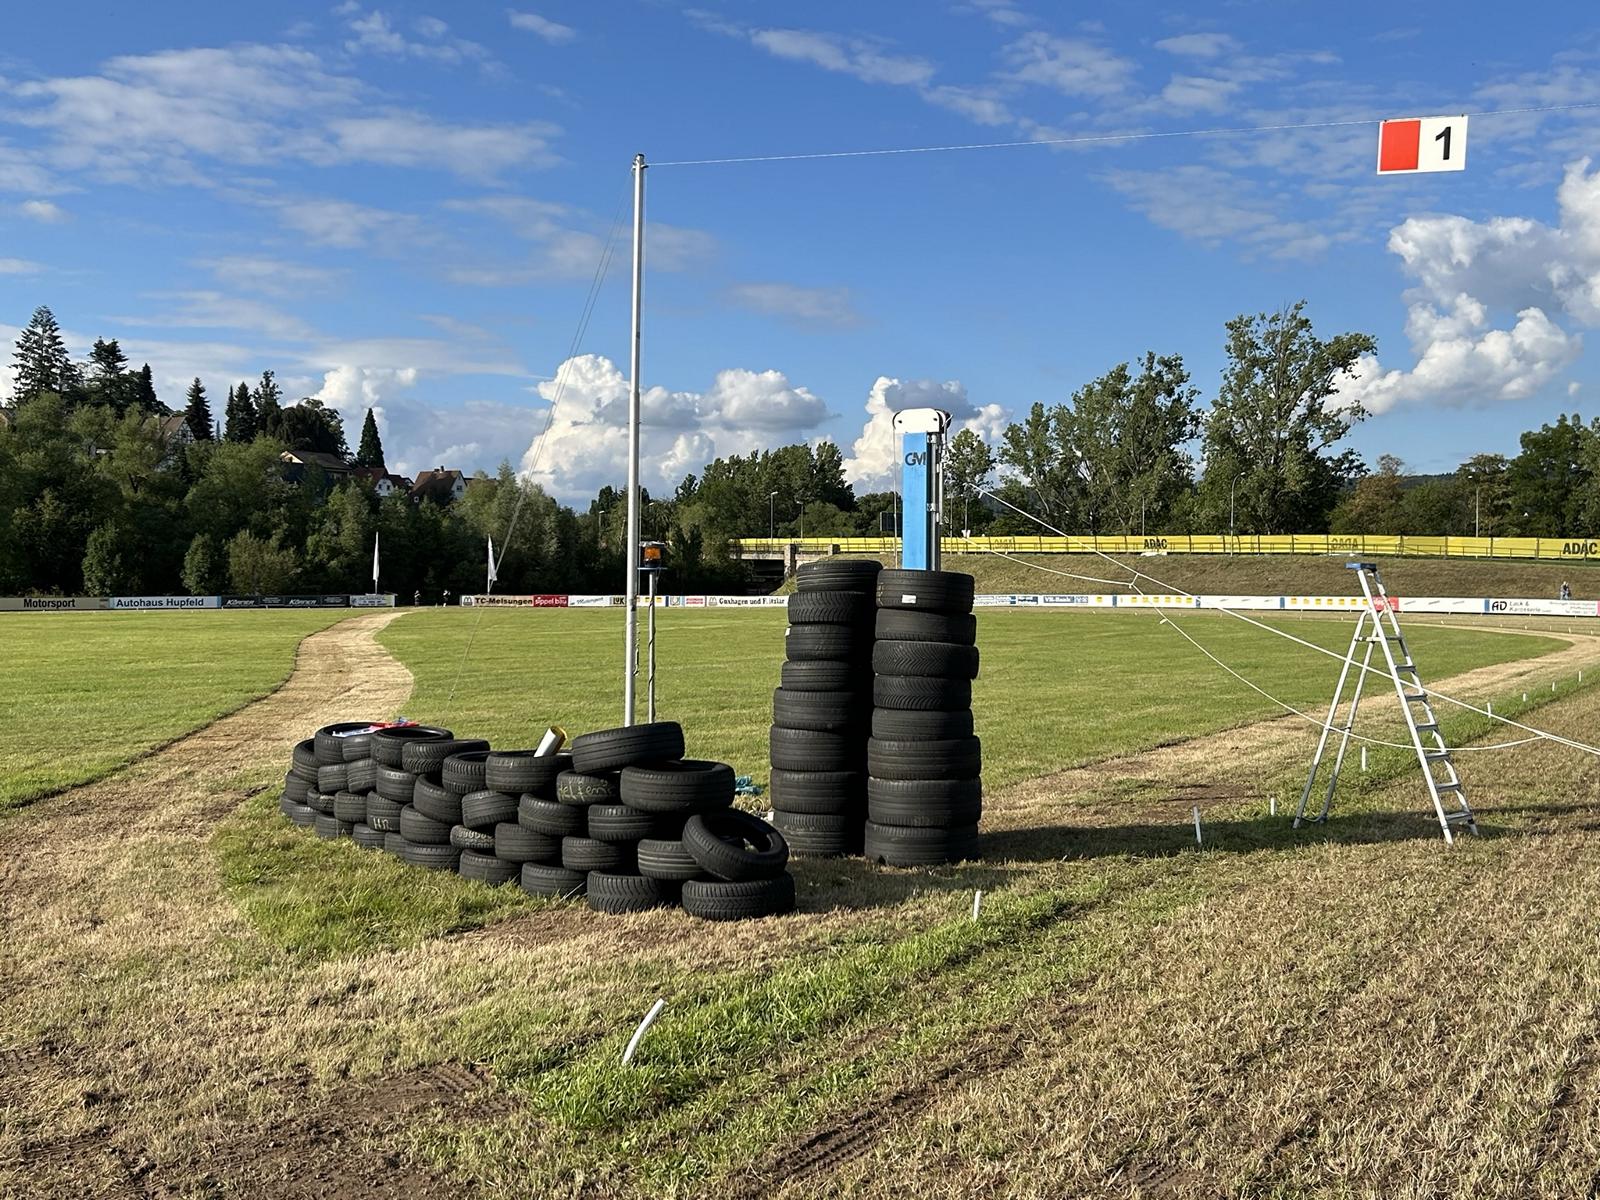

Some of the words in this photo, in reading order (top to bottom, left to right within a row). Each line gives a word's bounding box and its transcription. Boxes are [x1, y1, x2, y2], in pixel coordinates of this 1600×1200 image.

[1435, 126, 1452, 161] 1
[1143, 538, 1168, 550] ADAC
[1562, 542, 1598, 555] ADAC
[23, 598, 76, 609] Motorsport
[116, 598, 164, 608] Autohaus
[166, 597, 205, 608] Hupfeld
[474, 597, 533, 606] TC-Melsungen
[749, 597, 762, 605] und
[1491, 601, 1508, 612] AD
